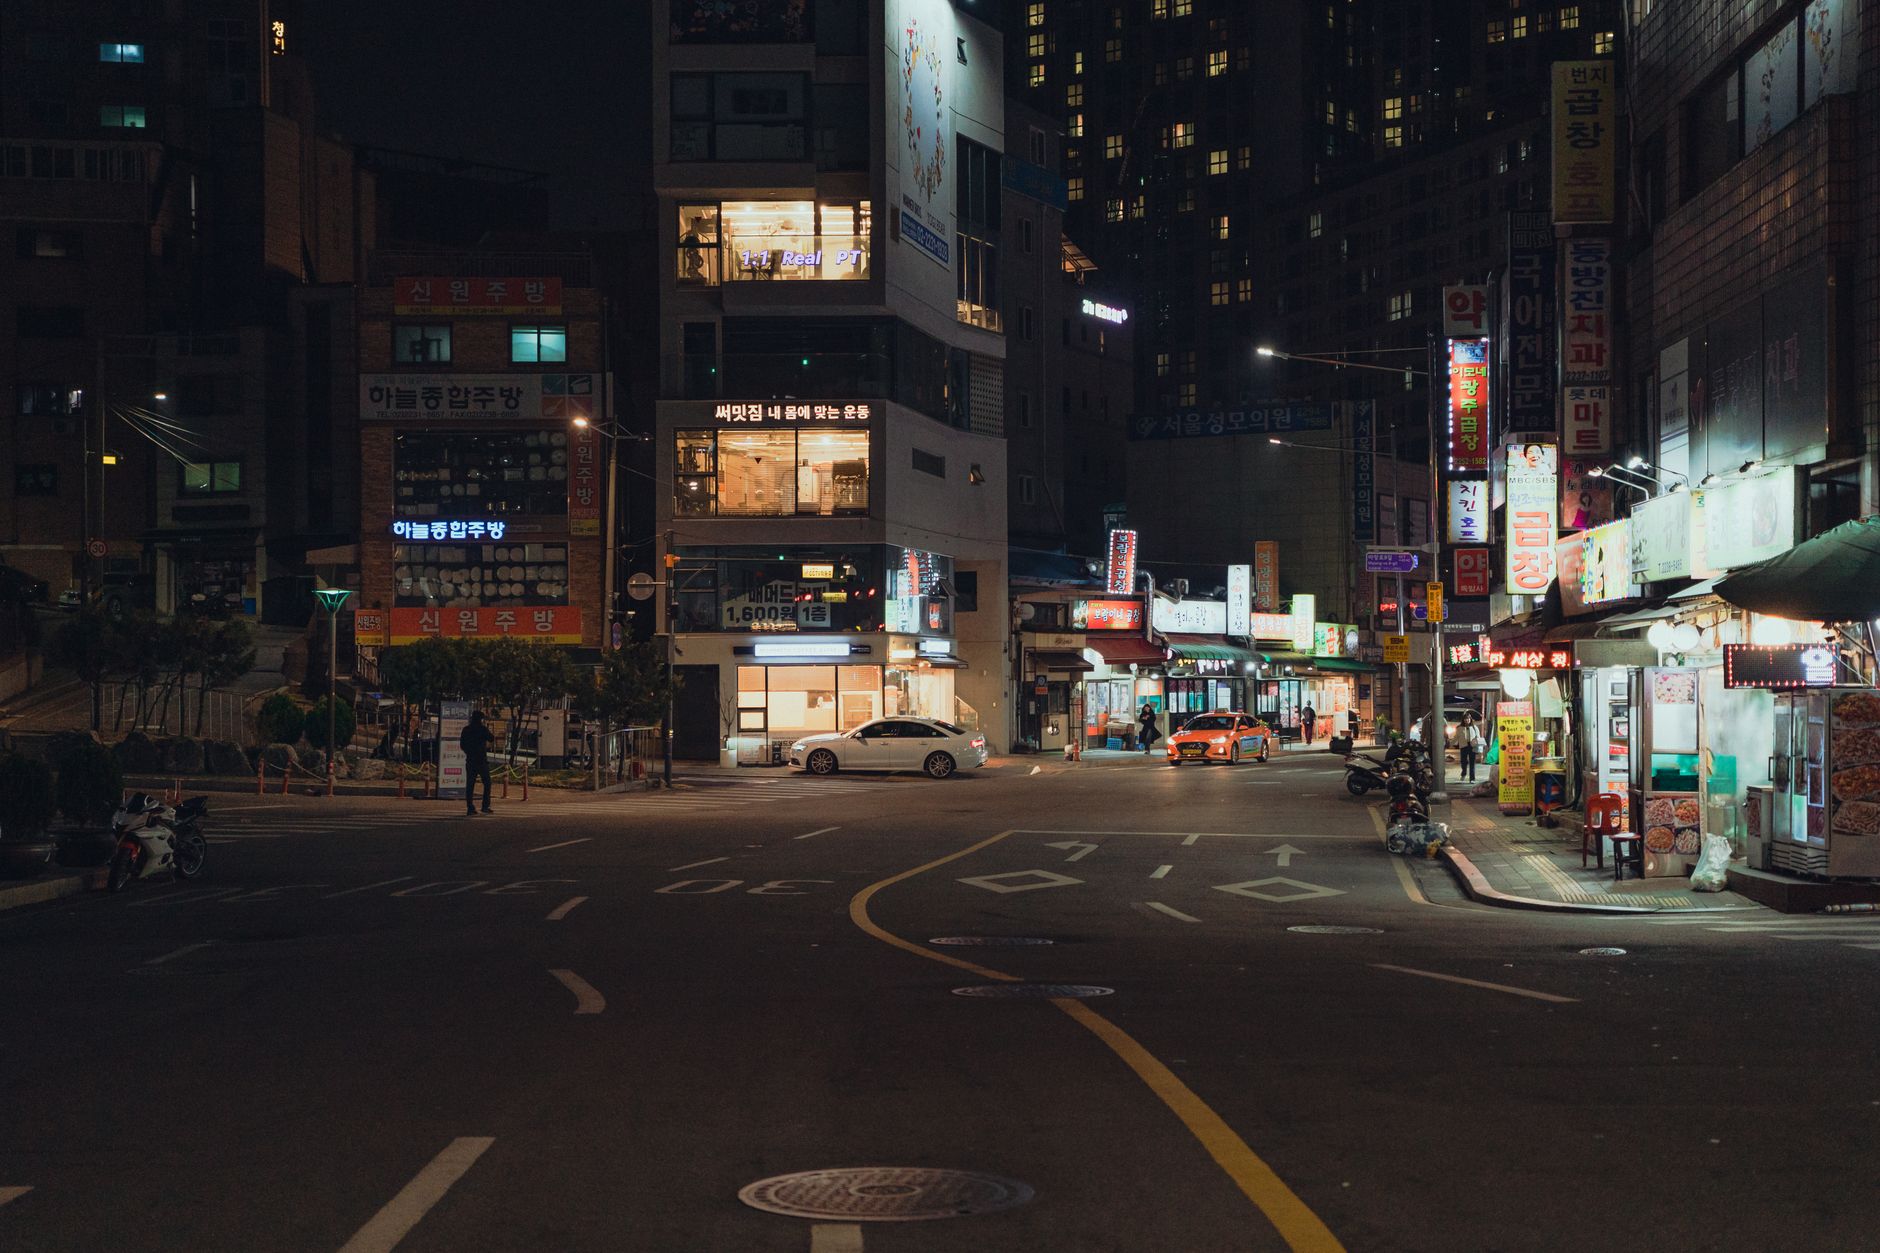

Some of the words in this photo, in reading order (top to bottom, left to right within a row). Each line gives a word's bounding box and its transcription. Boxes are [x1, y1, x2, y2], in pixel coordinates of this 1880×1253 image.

[1564, 89, 1604, 149] 곱창
[742, 250, 769, 266] 1:1
[782, 249, 822, 266] Real
[836, 250, 862, 265] PT
[410, 280, 546, 303] 신원주방
[1446, 290, 1486, 329] 약
[1452, 366, 1487, 378] 이모네
[369, 386, 523, 411] 하늘종합주방
[715, 404, 763, 422] 써밋짐
[768, 405, 781, 420] 내
[785, 405, 810, 420] 몸에
[814, 405, 839, 420] 맞는
[843, 405, 870, 420] 운동
[1459, 380, 1479, 451] 광주곱창
[1573, 402, 1602, 450] 마트
[576, 427, 594, 505] 신원주방
[393, 520, 506, 540] 하늘종합주방
[91, 545, 104, 554] 30
[1511, 511, 1553, 590] 곱창
[1459, 553, 1487, 584] 약
[418, 610, 555, 632] 신원주방
[802, 605, 827, 622] 1층
